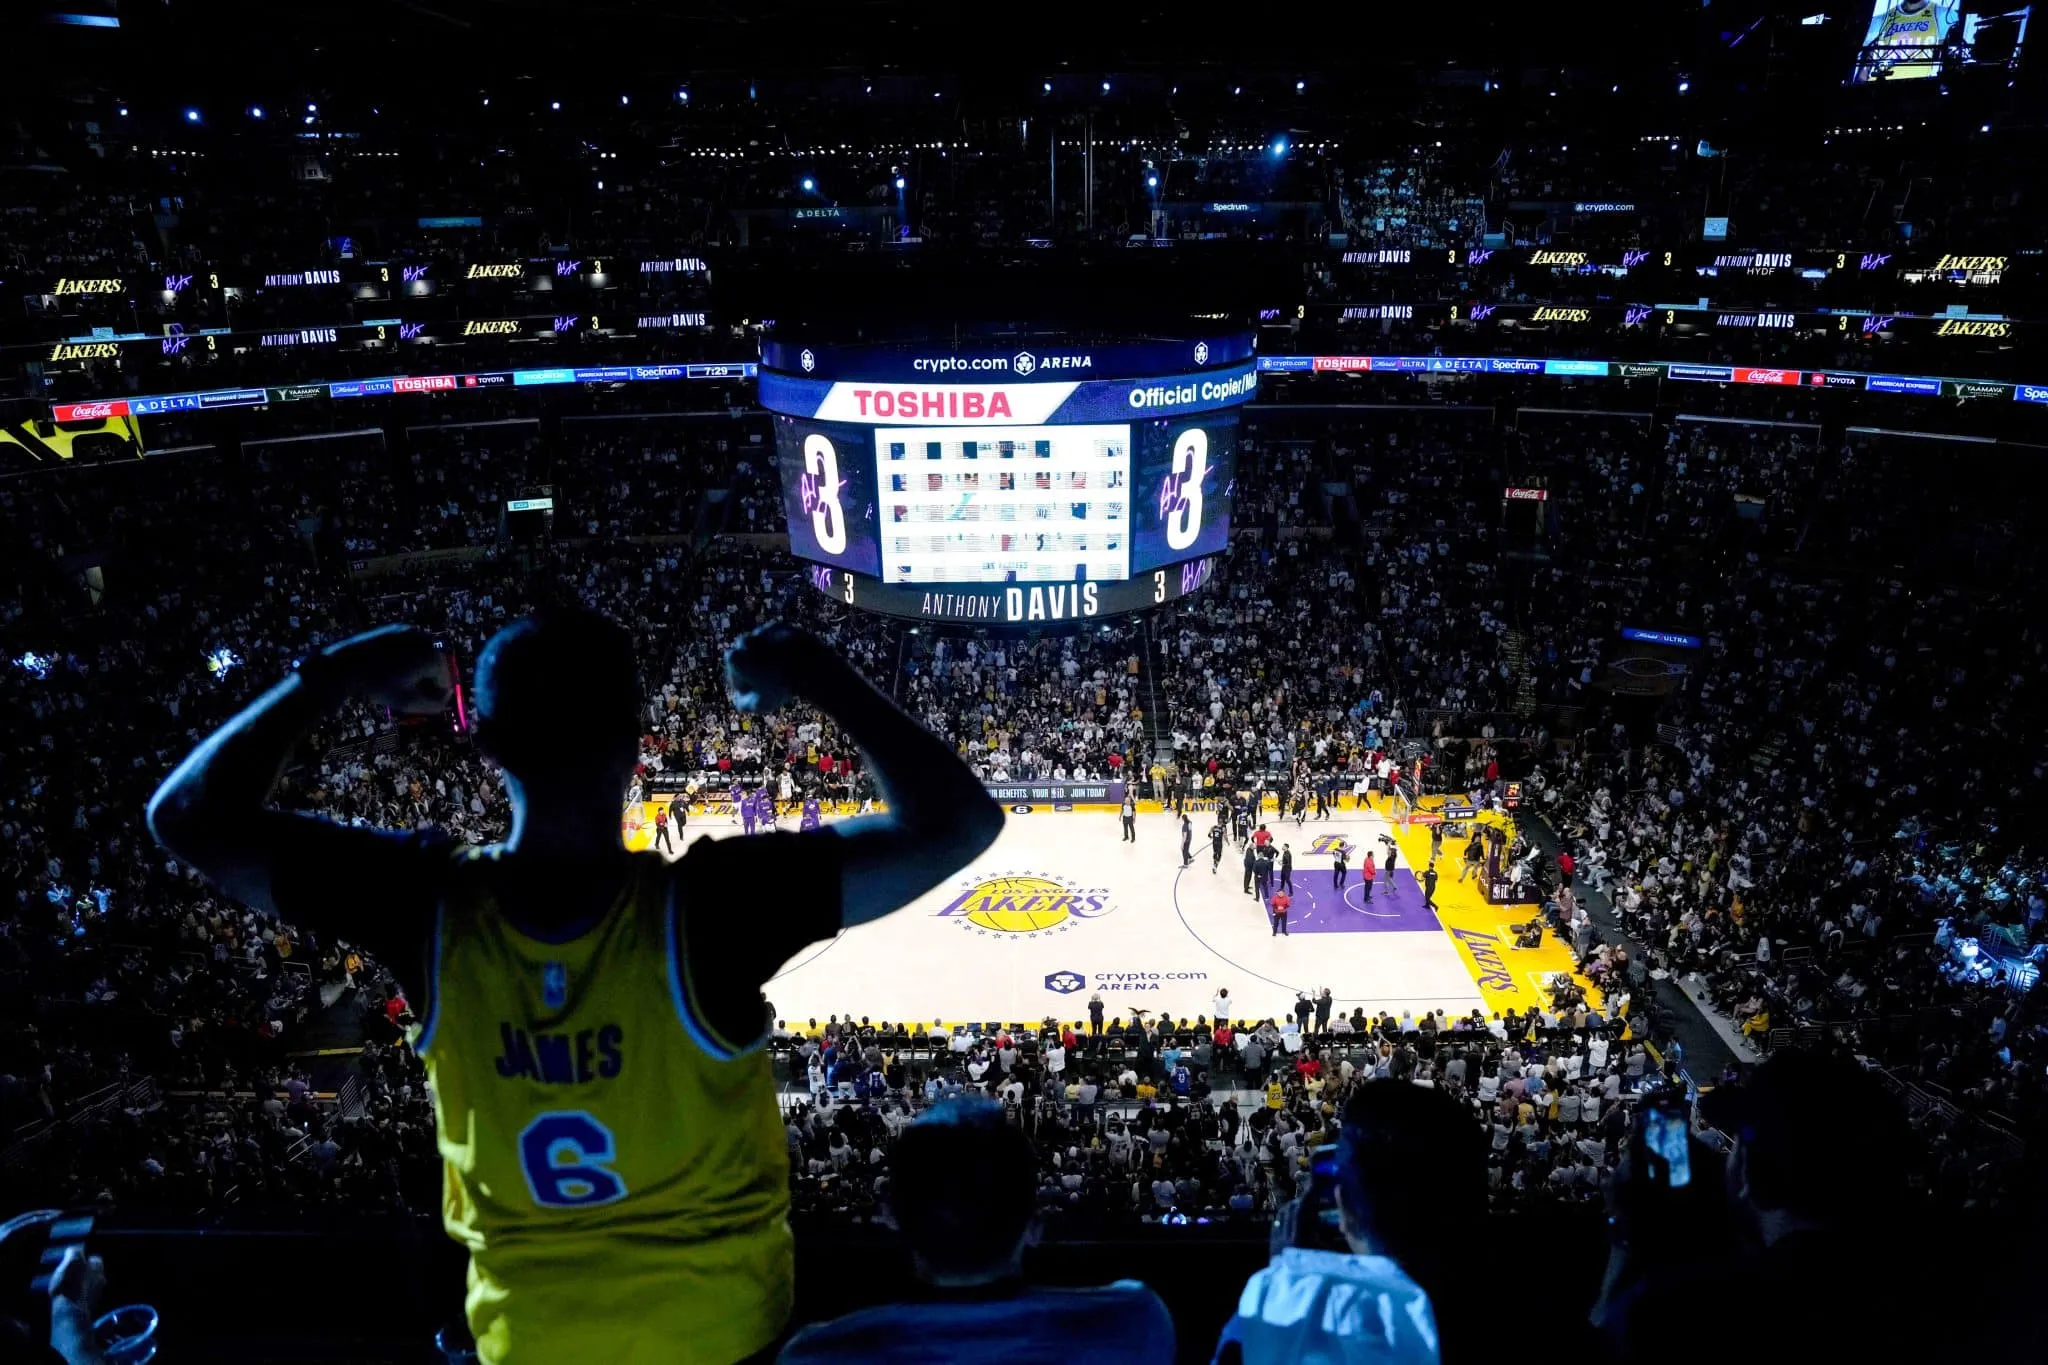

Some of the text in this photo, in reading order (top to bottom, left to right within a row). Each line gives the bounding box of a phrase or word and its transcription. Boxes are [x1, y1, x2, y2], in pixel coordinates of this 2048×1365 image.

[806, 209, 840, 217] DELTA
[1213, 203, 1248, 212] Spectrum
[1584, 203, 1635, 212] crypto.com
[1342, 250, 1411, 263] ANTHONY DAVIS
[1448, 250, 1456, 264] 3
[1526, 250, 1590, 266] LAKERS
[1664, 252, 1672, 266] 3
[1714, 253, 1792, 268] ANTHONY DAVIS
[1836, 254, 1846, 269] 3
[1934, 254, 2010, 271] LAKERS
[464, 264, 526, 279] LAKERS
[594, 260, 602, 274] 3
[640, 261, 675, 273] ANTHONY
[209, 274, 219, 289] 3
[264, 270, 341, 287] ANTHONY DAVIS
[380, 268, 389, 282] 3
[51, 278, 127, 295] LAKERS
[1297, 305, 1305, 319] 3
[1342, 306, 1413, 319] ANTHONY DAVIS
[1450, 306, 1458, 320] 3
[1528, 307, 1592, 323] LAKERS
[1666, 310, 1675, 325] 3
[591, 316, 599, 330] 3
[637, 314, 706, 329] ANTHONY DAVIS
[1716, 313, 1795, 328] ANTHONY DAVIS
[1839, 316, 1848, 331] 3
[377, 326, 386, 340] 3
[460, 321, 522, 336] LAKERS
[1936, 320, 2012, 338] LAKERS
[206, 336, 216, 350] 3
[261, 329, 337, 347] ANTHONY DAVIS
[48, 343, 123, 361] LAKERS
[913, 355, 1092, 372] crypto.com ARENA
[1272, 360, 1308, 369] crypto.com
[1316, 357, 1368, 368] TOSHIBA
[1445, 360, 1483, 369] DELTA
[1492, 360, 1537, 371] Spectrum
[636, 367, 680, 377] Spectrum
[704, 366, 728, 376] 7:29
[365, 383, 391, 391] ULTRA
[396, 378, 453, 390] TOSHIBA
[478, 376, 505, 384] TOYOTA
[1826, 376, 1856, 386] TOYOTA
[1129, 384, 1197, 408] Official
[2024, 387, 2048, 400] Spe
[150, 397, 195, 410] DELTA
[853, 390, 1012, 418] TOSHIBA
[804, 434, 847, 555] 3
[1166, 428, 1208, 550] 3
[843, 573, 855, 604] 3
[1154, 570, 1166, 603] 3
[922, 582, 1099, 622] ANTHONY DAVIS
[1663, 635, 1688, 644] ULTRA
[998, 788, 1029, 798] BENEFITS.
[1032, 788, 1049, 798] YOUR
[1071, 788, 1086, 798] JOIN
[1086, 788, 1106, 798] TODAY
[929, 889, 1118, 918] LAKERS
[1448, 925, 1518, 993] LAKERS
[1095, 971, 1208, 982] crypto.com
[1096, 983, 1160, 991] ARENA
[495, 1021, 623, 1084] JAMES
[518, 1109, 629, 1208] 6
